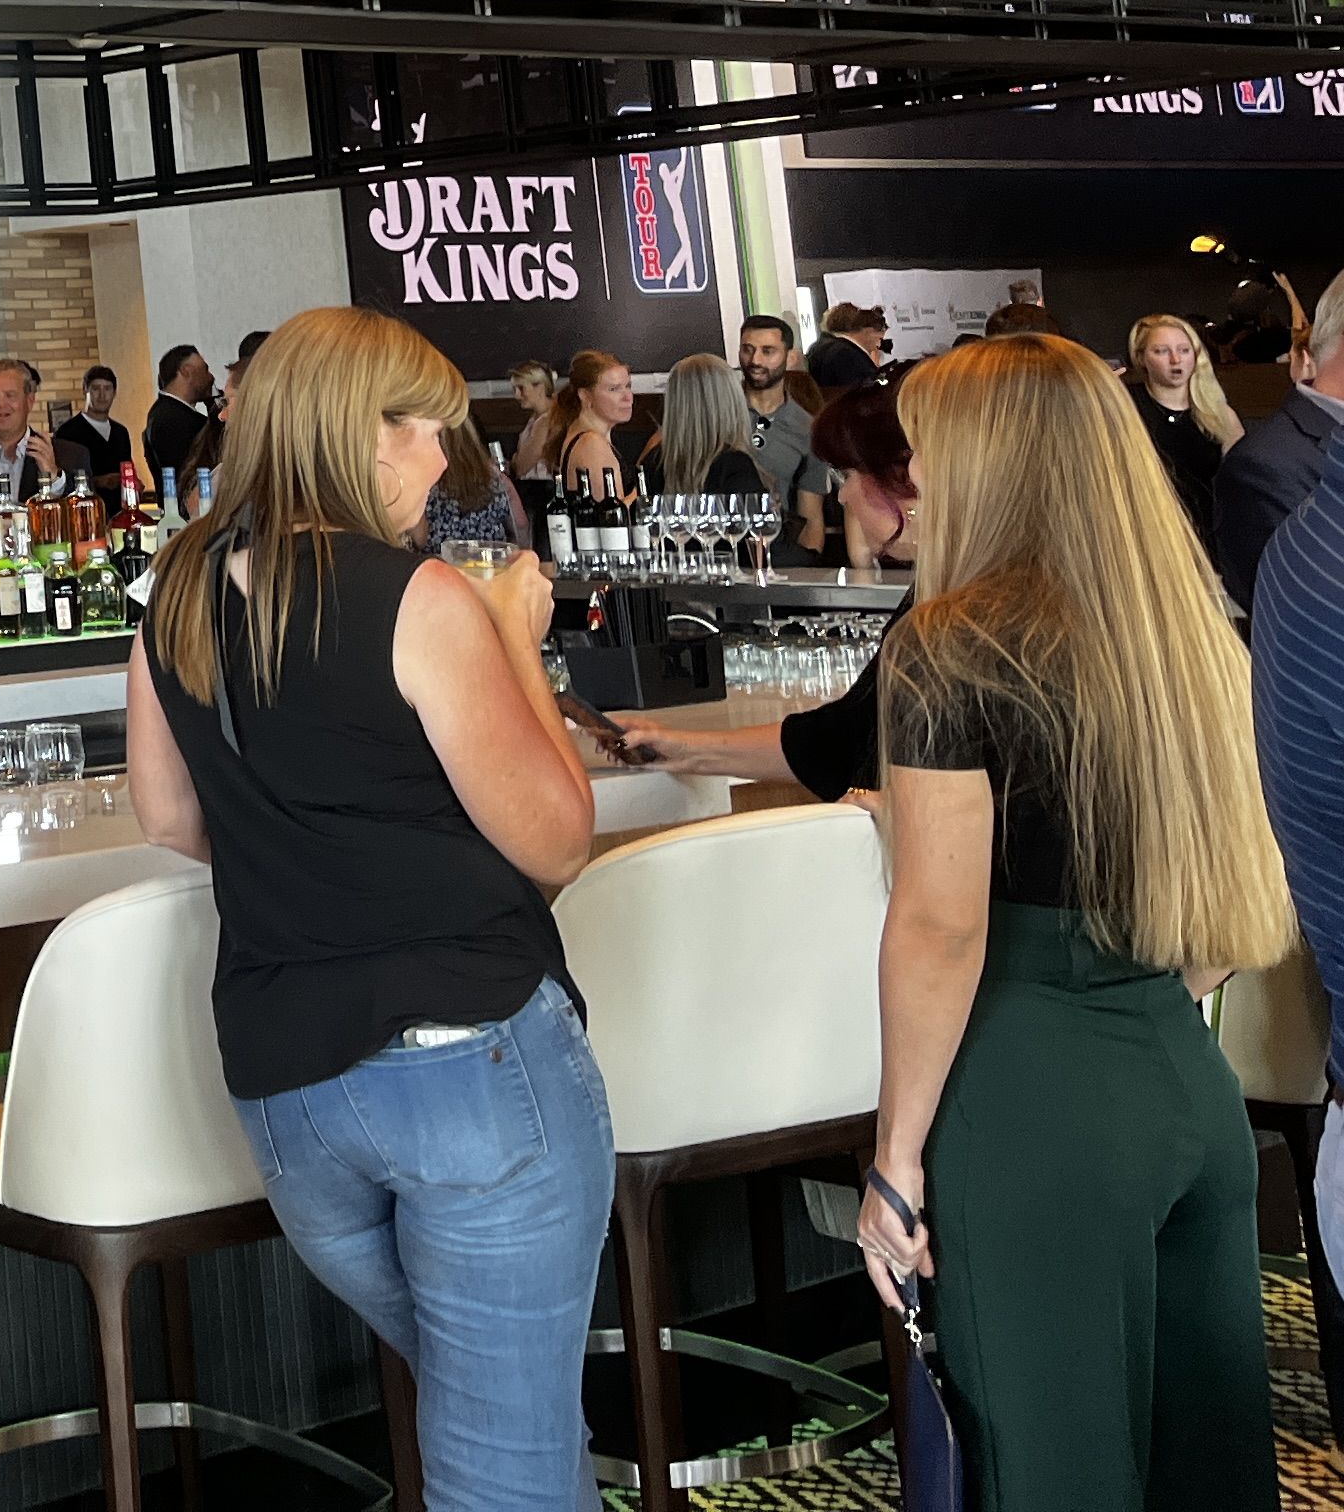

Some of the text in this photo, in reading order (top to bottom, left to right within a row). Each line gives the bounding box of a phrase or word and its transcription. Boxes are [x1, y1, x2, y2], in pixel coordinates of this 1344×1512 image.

[368, 176, 577, 252] DRAFT
[627, 152, 665, 281] TOUR
[403, 238, 580, 304] KINGS
